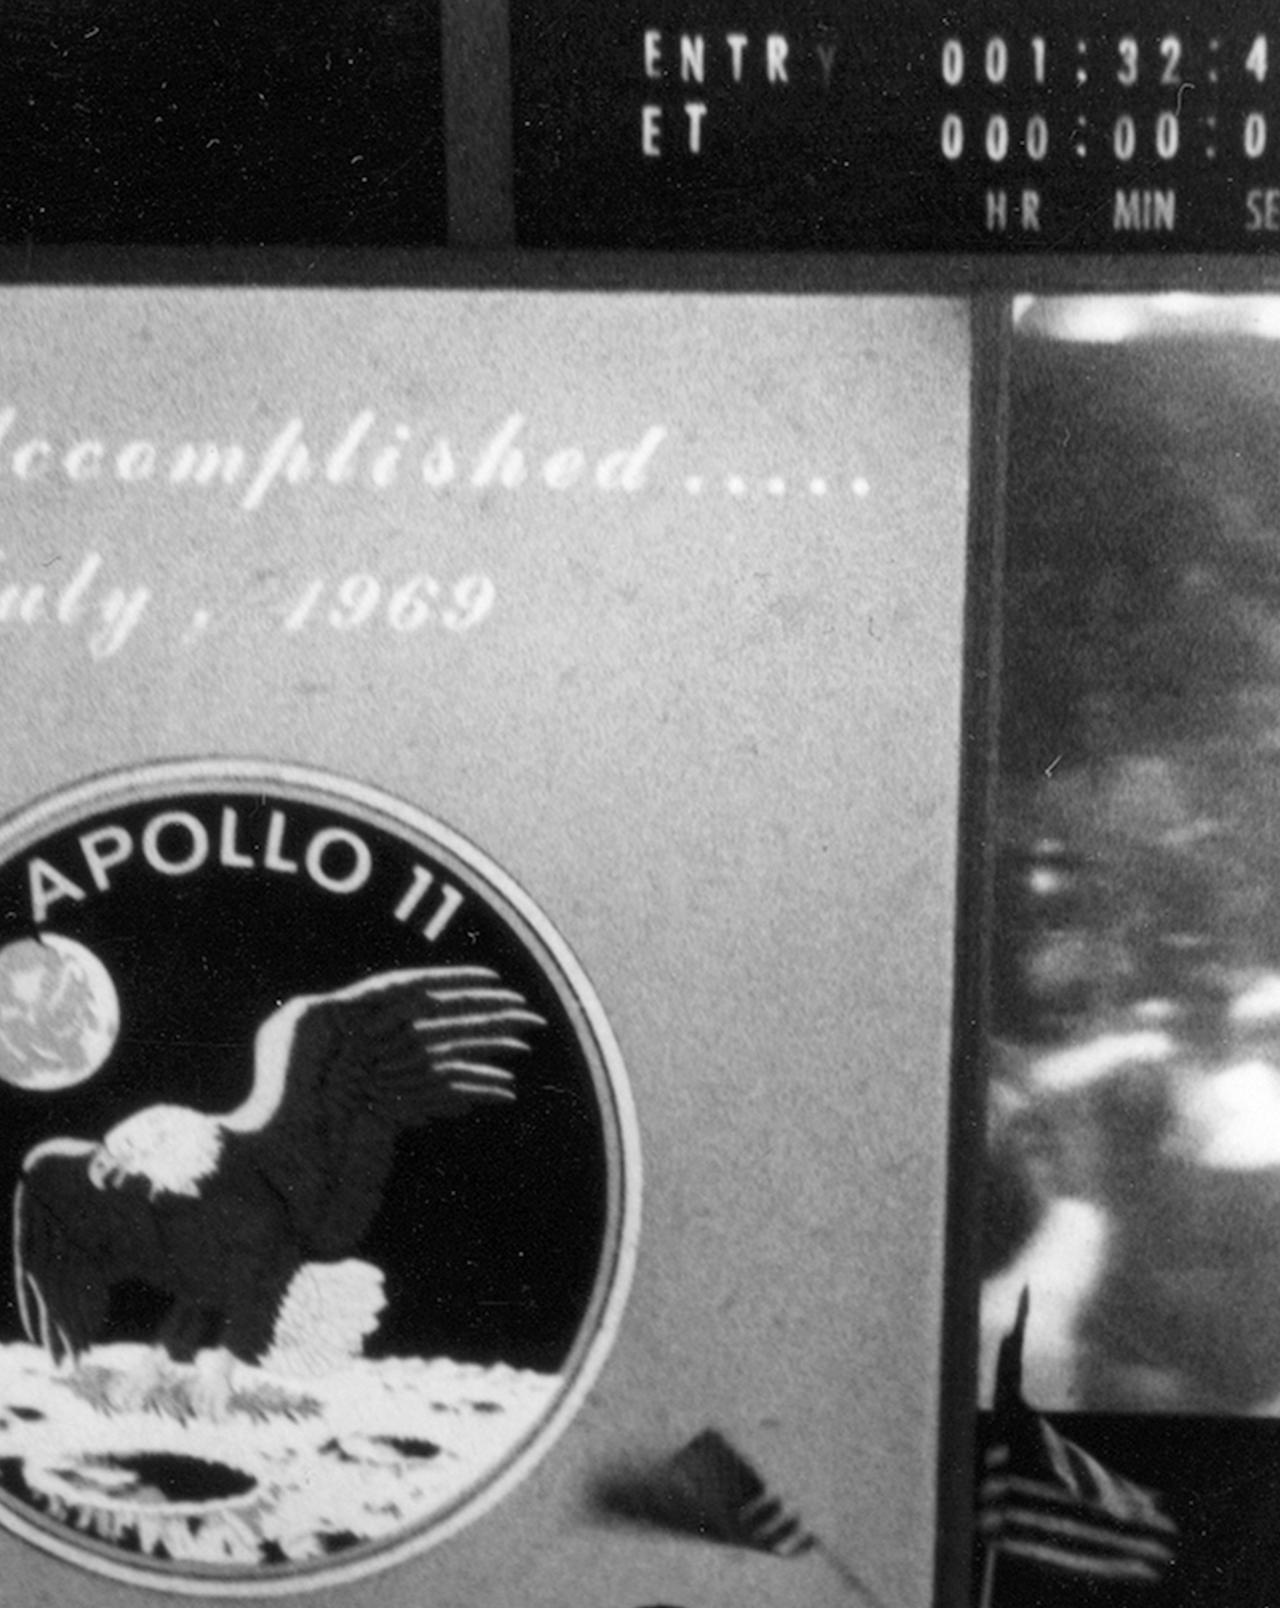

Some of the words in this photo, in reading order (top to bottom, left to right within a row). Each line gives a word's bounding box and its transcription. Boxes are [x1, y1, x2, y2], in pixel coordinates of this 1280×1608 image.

[641, 102, 708, 156] ET
[986, 189, 1041, 231] HR
[1114, 189, 1175, 231] MIN
[282, 573, 496, 632] 1969
[26, 807, 371, 922] APOLLO
[393, 866, 465, 942] 11
